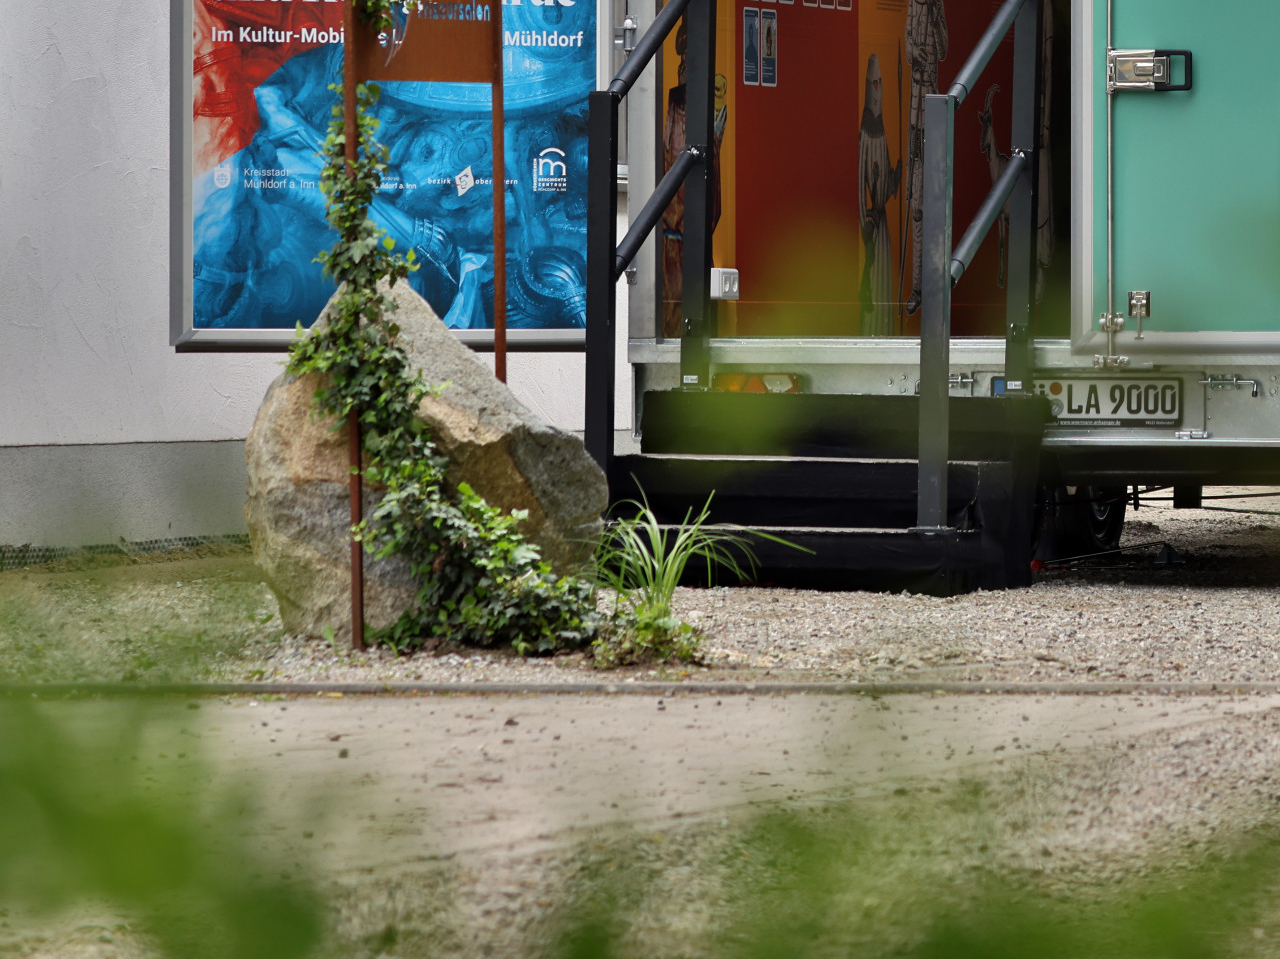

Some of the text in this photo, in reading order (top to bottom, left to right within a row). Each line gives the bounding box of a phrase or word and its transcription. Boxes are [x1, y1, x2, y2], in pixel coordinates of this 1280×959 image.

[211, 26, 344, 44] Im Kultur-Mobi
[505, 30, 584, 47] Mühldorf
[244, 167, 289, 177] Kreisstadt
[300, 179, 315, 189] Inn
[427, 177, 518, 185] bezirk oberern
[1066, 384, 1176, 415] LA 9000
